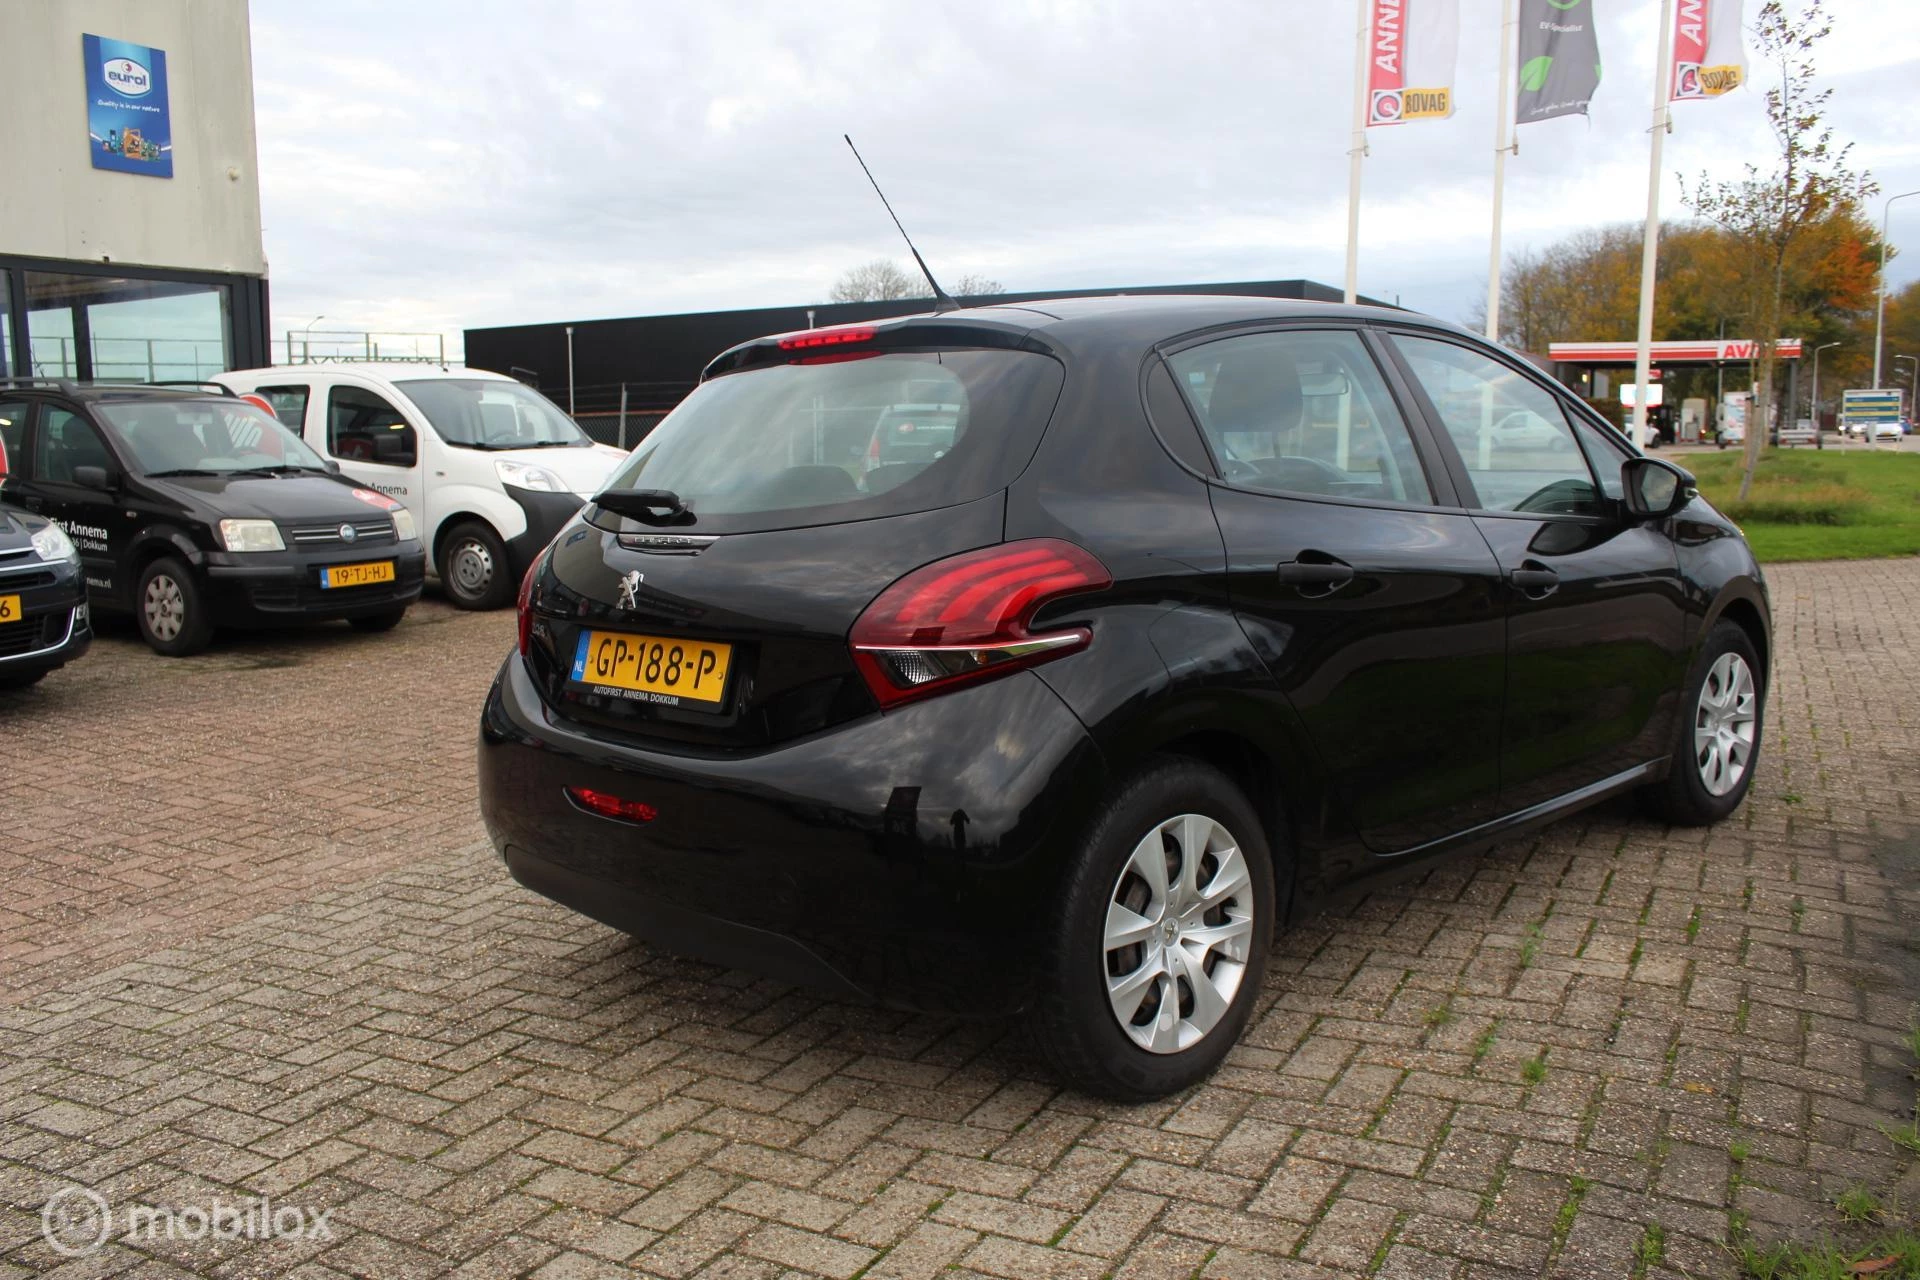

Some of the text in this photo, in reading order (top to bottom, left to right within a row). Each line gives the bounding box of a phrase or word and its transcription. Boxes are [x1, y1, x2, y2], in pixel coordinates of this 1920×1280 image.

[108, 72, 146, 86] eurol
[1404, 92, 1446, 114] BOVAG
[70, 521, 107, 539] Annema
[83, 540, 107, 552] Dokkum
[335, 565, 387, 585] 19-TJ-HJ
[574, 660, 584, 673] NL
[596, 637, 717, 690] GP-188-P
[593, 685, 679, 706] AUTOFIRST ANNEMA DOKKUM
